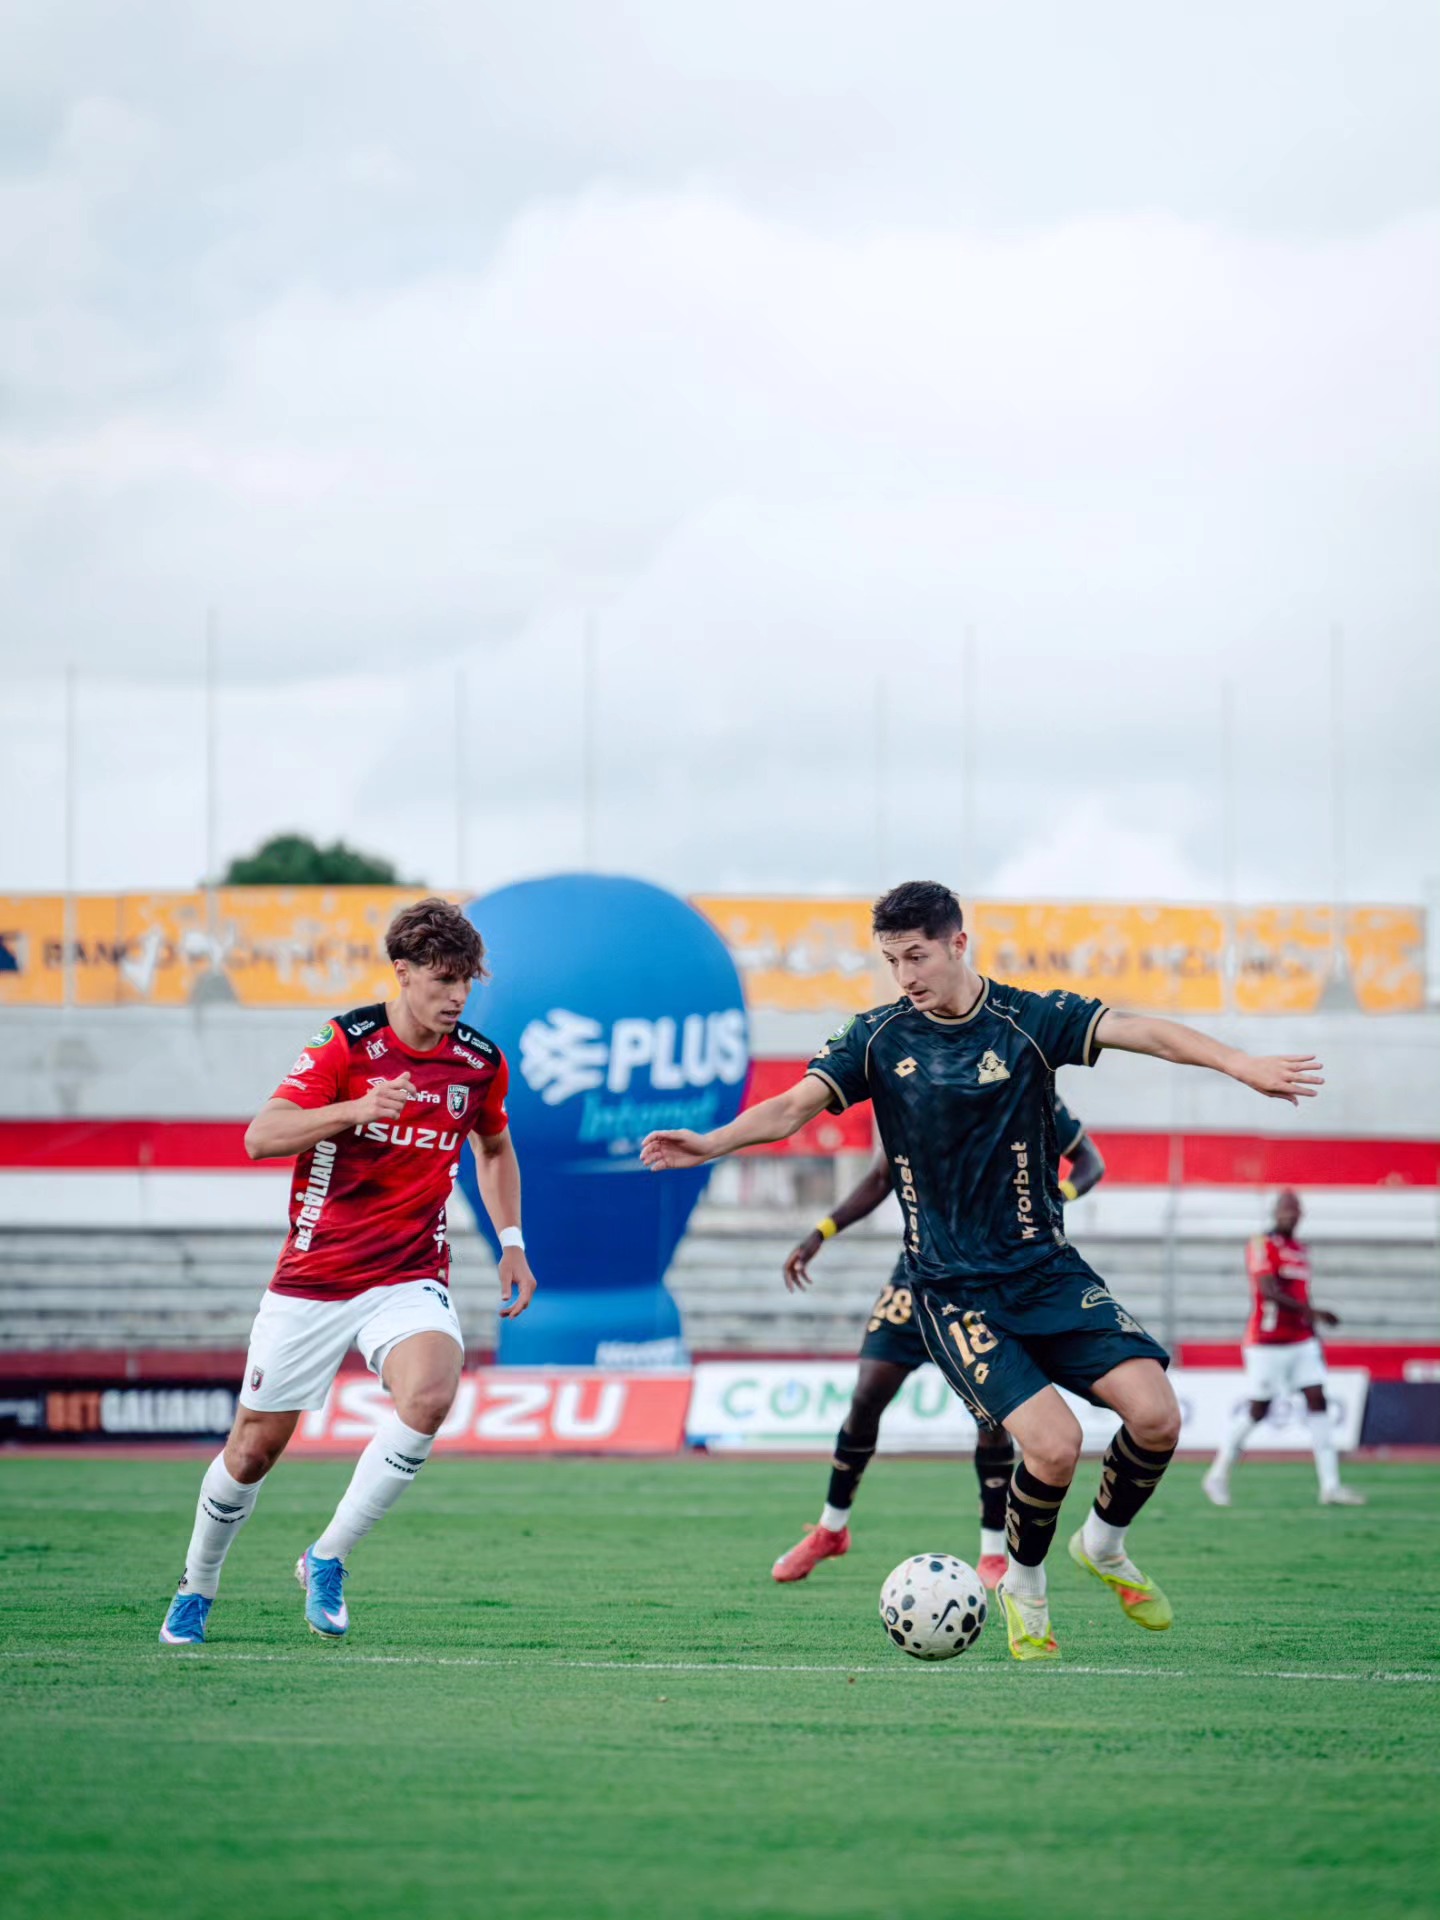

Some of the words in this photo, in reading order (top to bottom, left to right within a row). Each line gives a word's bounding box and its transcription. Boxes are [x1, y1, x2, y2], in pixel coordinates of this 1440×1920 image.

[607, 1008, 747, 1093] PLUS
[399, 1089, 441, 1104] anFra
[354, 1122, 459, 1151] ISUZU
[873, 1285, 912, 1325] 28
[948, 1309, 999, 1368] 18
[721, 1379, 950, 1420] COMU
